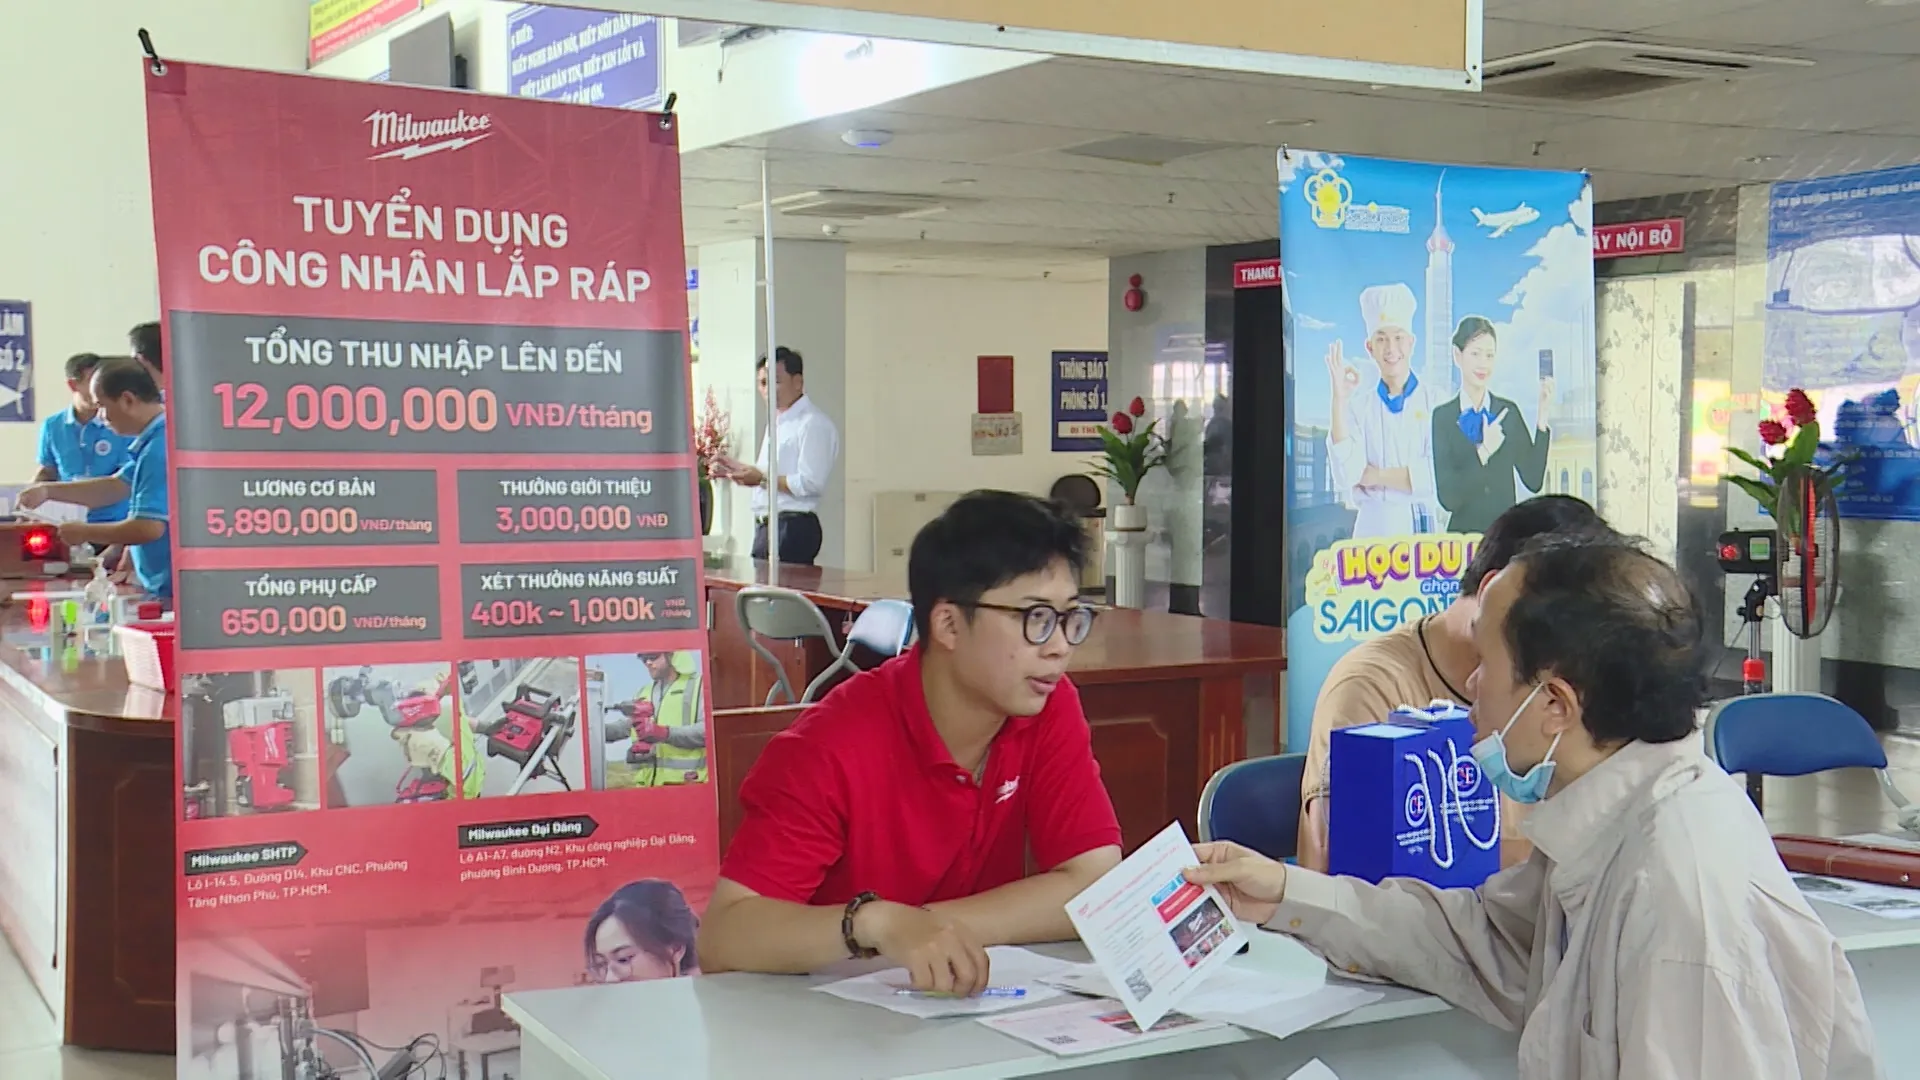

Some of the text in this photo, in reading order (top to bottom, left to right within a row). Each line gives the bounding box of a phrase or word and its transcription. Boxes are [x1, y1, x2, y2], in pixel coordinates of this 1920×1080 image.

[363, 109, 492, 149] Milwaukee
[294, 188, 568, 253] TUYỂN DỤNG
[1616, 227, 1644, 250] NỘI
[1649, 223, 1672, 248] BỘ
[199, 239, 651, 303] CÔNG NHÂN LẮP RÁP
[1240, 265, 1276, 282] THANG
[246, 327, 622, 376] TỔNG THU NHẬP LÊN ĐẾN
[214, 383, 653, 436] 12,000,000 VNĐ/tháng
[243, 476, 376, 496] LƯƠNG CƠ BẢN
[500, 477, 652, 498] THƯỞNG GIỚI THIỆU
[207, 507, 433, 538] 5,890,000 VNĐ/tháng
[496, 505, 669, 534] 3,000,000 VNĐ
[480, 566, 679, 591] XÉT THƯỞNG NĂNG SUẤT
[1337, 543, 1410, 590] HỌC
[1415, 541, 1462, 578] DU
[245, 573, 377, 598] TỔNG PHỤ CẤP
[221, 605, 347, 636] 650,000
[471, 600, 543, 626] 400k
[569, 597, 655, 626] 1,000k
[468, 825, 529, 842] Milwaukee
[191, 846, 297, 868] Milwaukee SHTP
[565, 843, 586, 854] Khu
[311, 866, 333, 877] Khu
